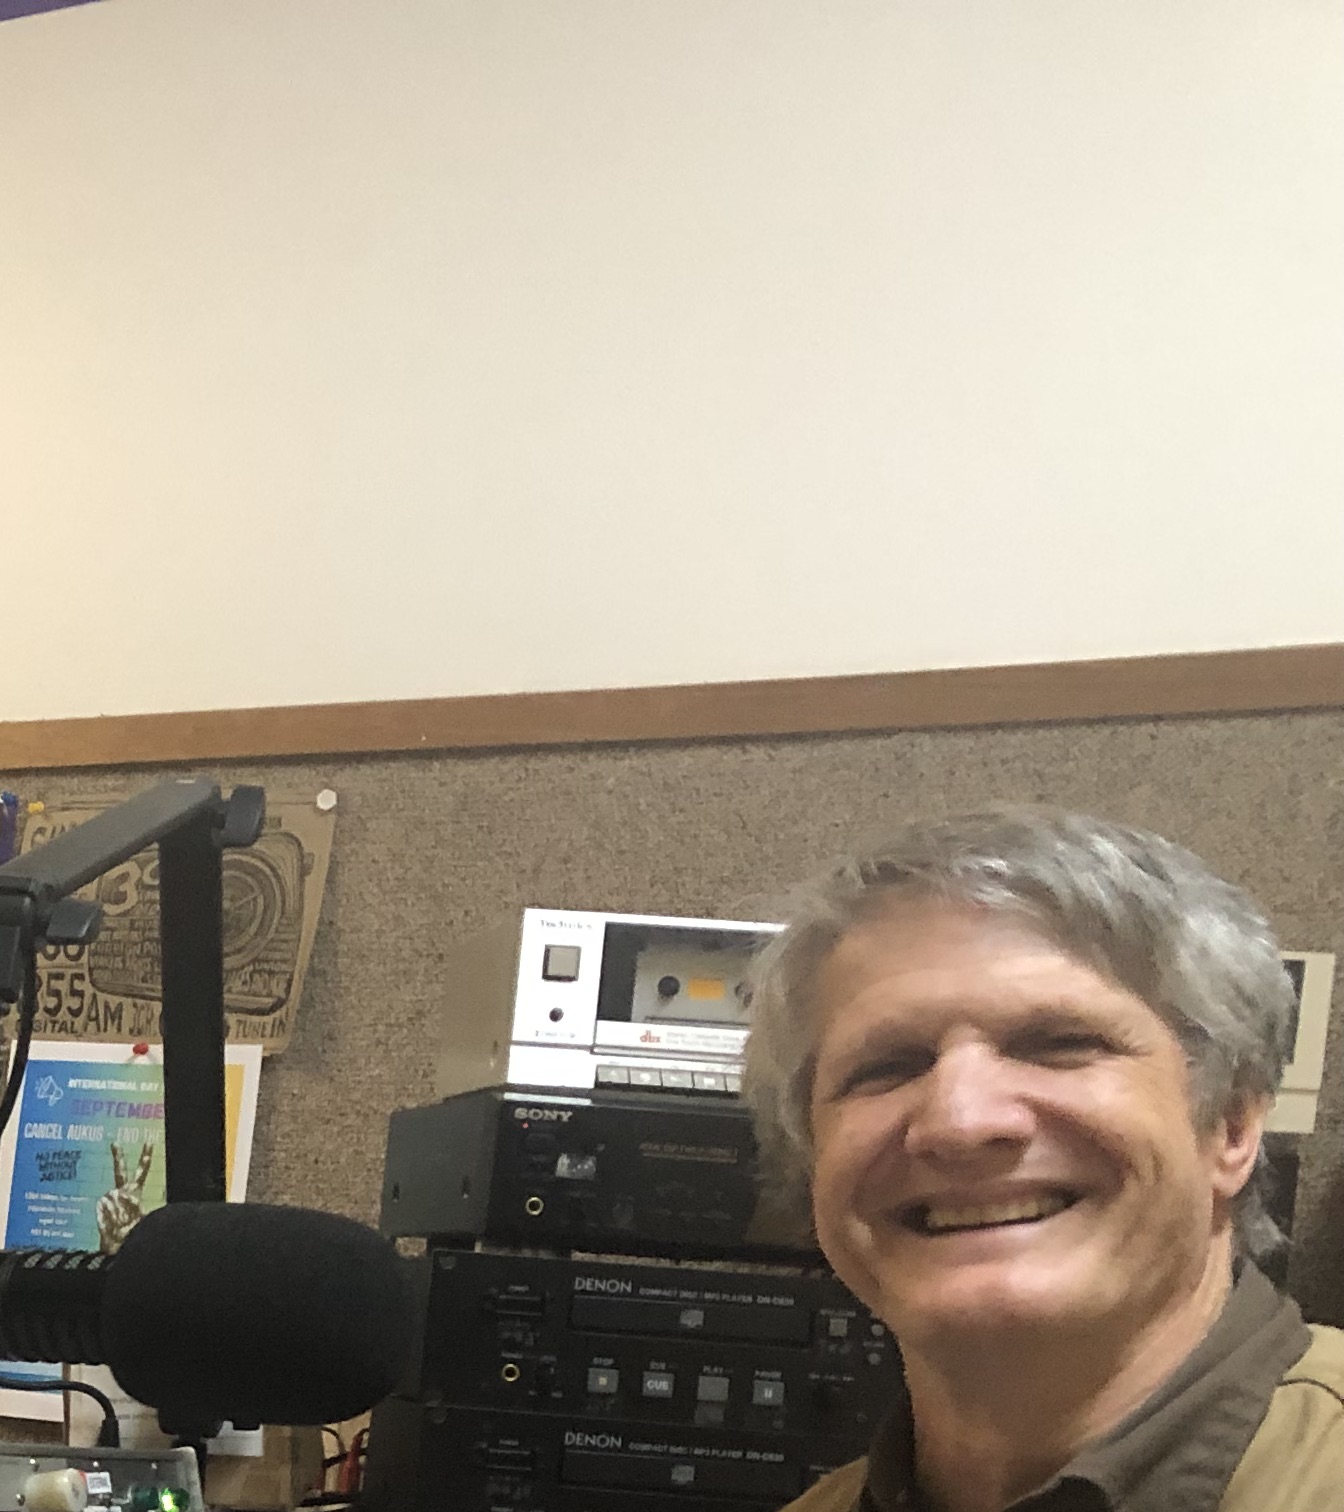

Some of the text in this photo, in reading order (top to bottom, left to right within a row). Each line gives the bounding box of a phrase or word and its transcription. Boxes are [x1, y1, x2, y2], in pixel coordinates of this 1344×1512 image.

[33, 971, 86, 1018] 55
[639, 1030, 662, 1044] dbx
[68, 1078, 136, 1090] INTERNATIONAL
[71, 1099, 165, 1119] SEPTEMBE
[514, 1107, 574, 1123] SONY
[24, 1122, 63, 1141] CANCEL
[67, 1124, 104, 1141] AUKUS
[117, 1126, 139, 1143] END
[574, 1276, 633, 1293] DENON
[647, 1379, 669, 1390] CUE
[564, 1431, 623, 1449] DENON
